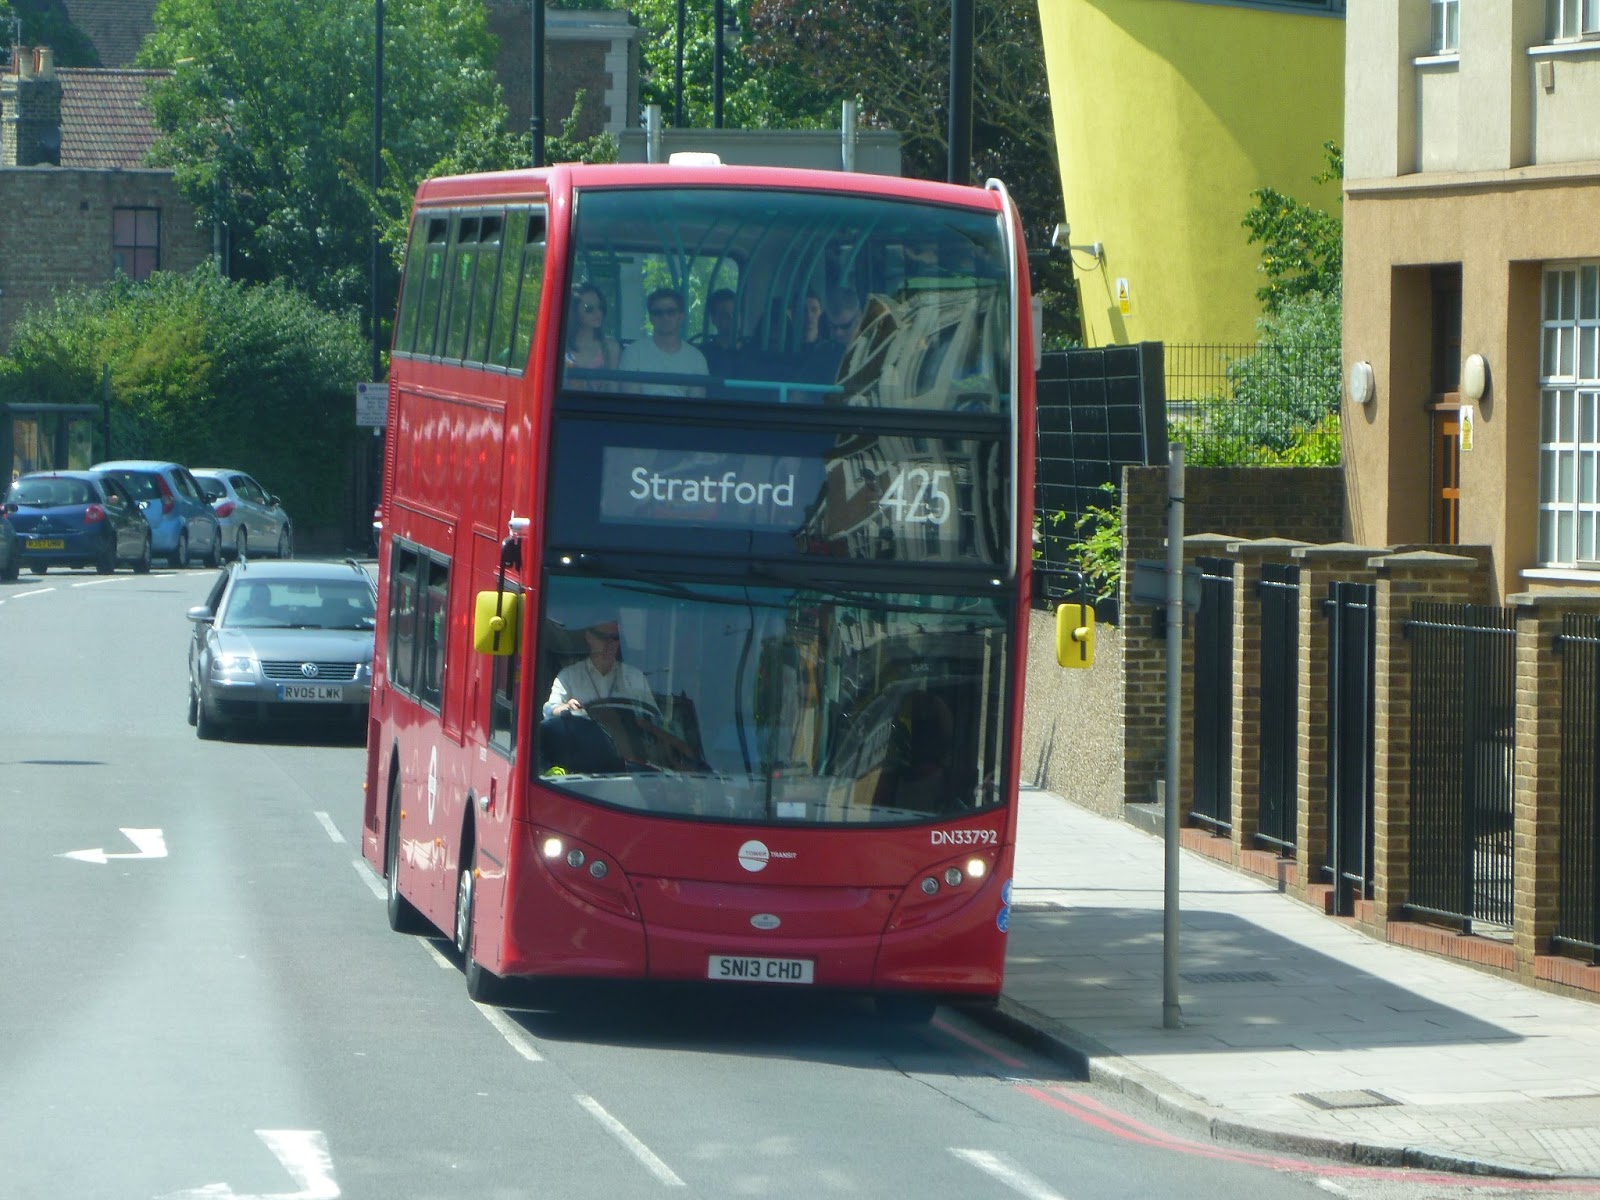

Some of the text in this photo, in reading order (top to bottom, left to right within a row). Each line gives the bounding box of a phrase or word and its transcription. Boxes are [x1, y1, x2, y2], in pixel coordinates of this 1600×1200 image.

[630, 467, 794, 506] Stratford
[879, 468, 951, 525] 425
[285, 687, 315, 698] RV05
[931, 829, 998, 846] DN33792
[770, 851, 797, 859] TRANSIT
[720, 959, 802, 979] SN13 CHD
